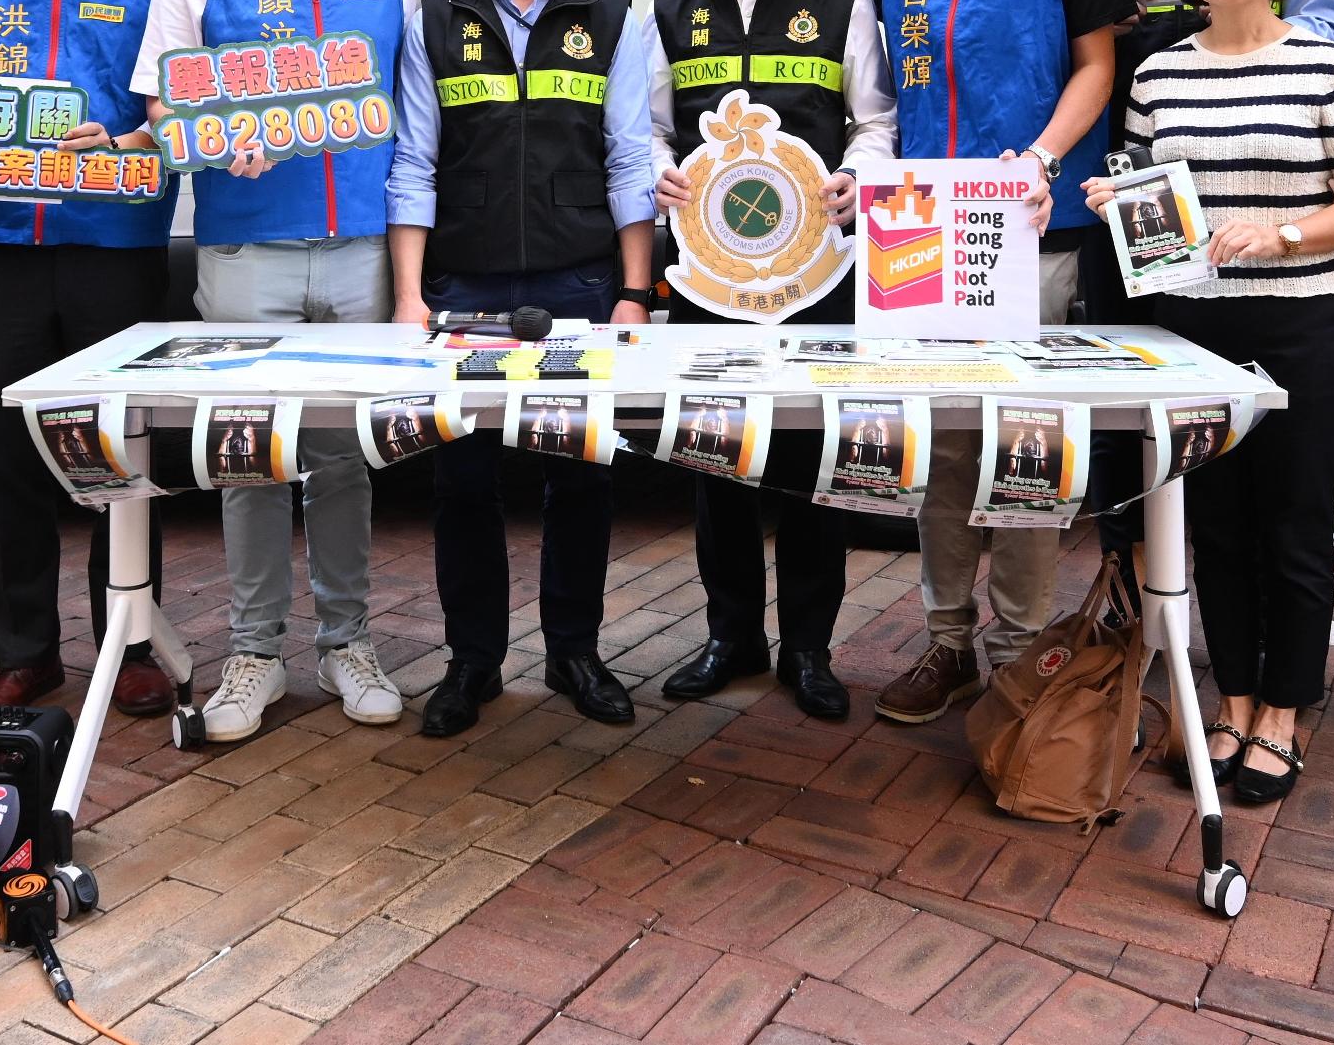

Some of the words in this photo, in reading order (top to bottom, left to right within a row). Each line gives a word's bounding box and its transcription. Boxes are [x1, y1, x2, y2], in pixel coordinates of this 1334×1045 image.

[691, 7, 709, 47] 海關
[462, 21, 483, 62] 海關
[168, 40, 373, 102] 舉報熱線
[163, 97, 390, 160] 1828080
[718, 169, 744, 190] HONG
[747, 168, 775, 181] KONG
[953, 181, 1029, 199] HKDNP
[715, 220, 754, 251] CUSTOMS
[756, 238, 775, 251] AND
[775, 208, 793, 242] EXCISE
[954, 209, 1004, 228] Hong
[954, 229, 1003, 249] Kong
[890, 245, 941, 274] HKDNP
[954, 250, 998, 269] Duty
[954, 270, 987, 286] Not
[736, 284, 801, 309] 香港海關
[954, 290, 995, 306] Paid
